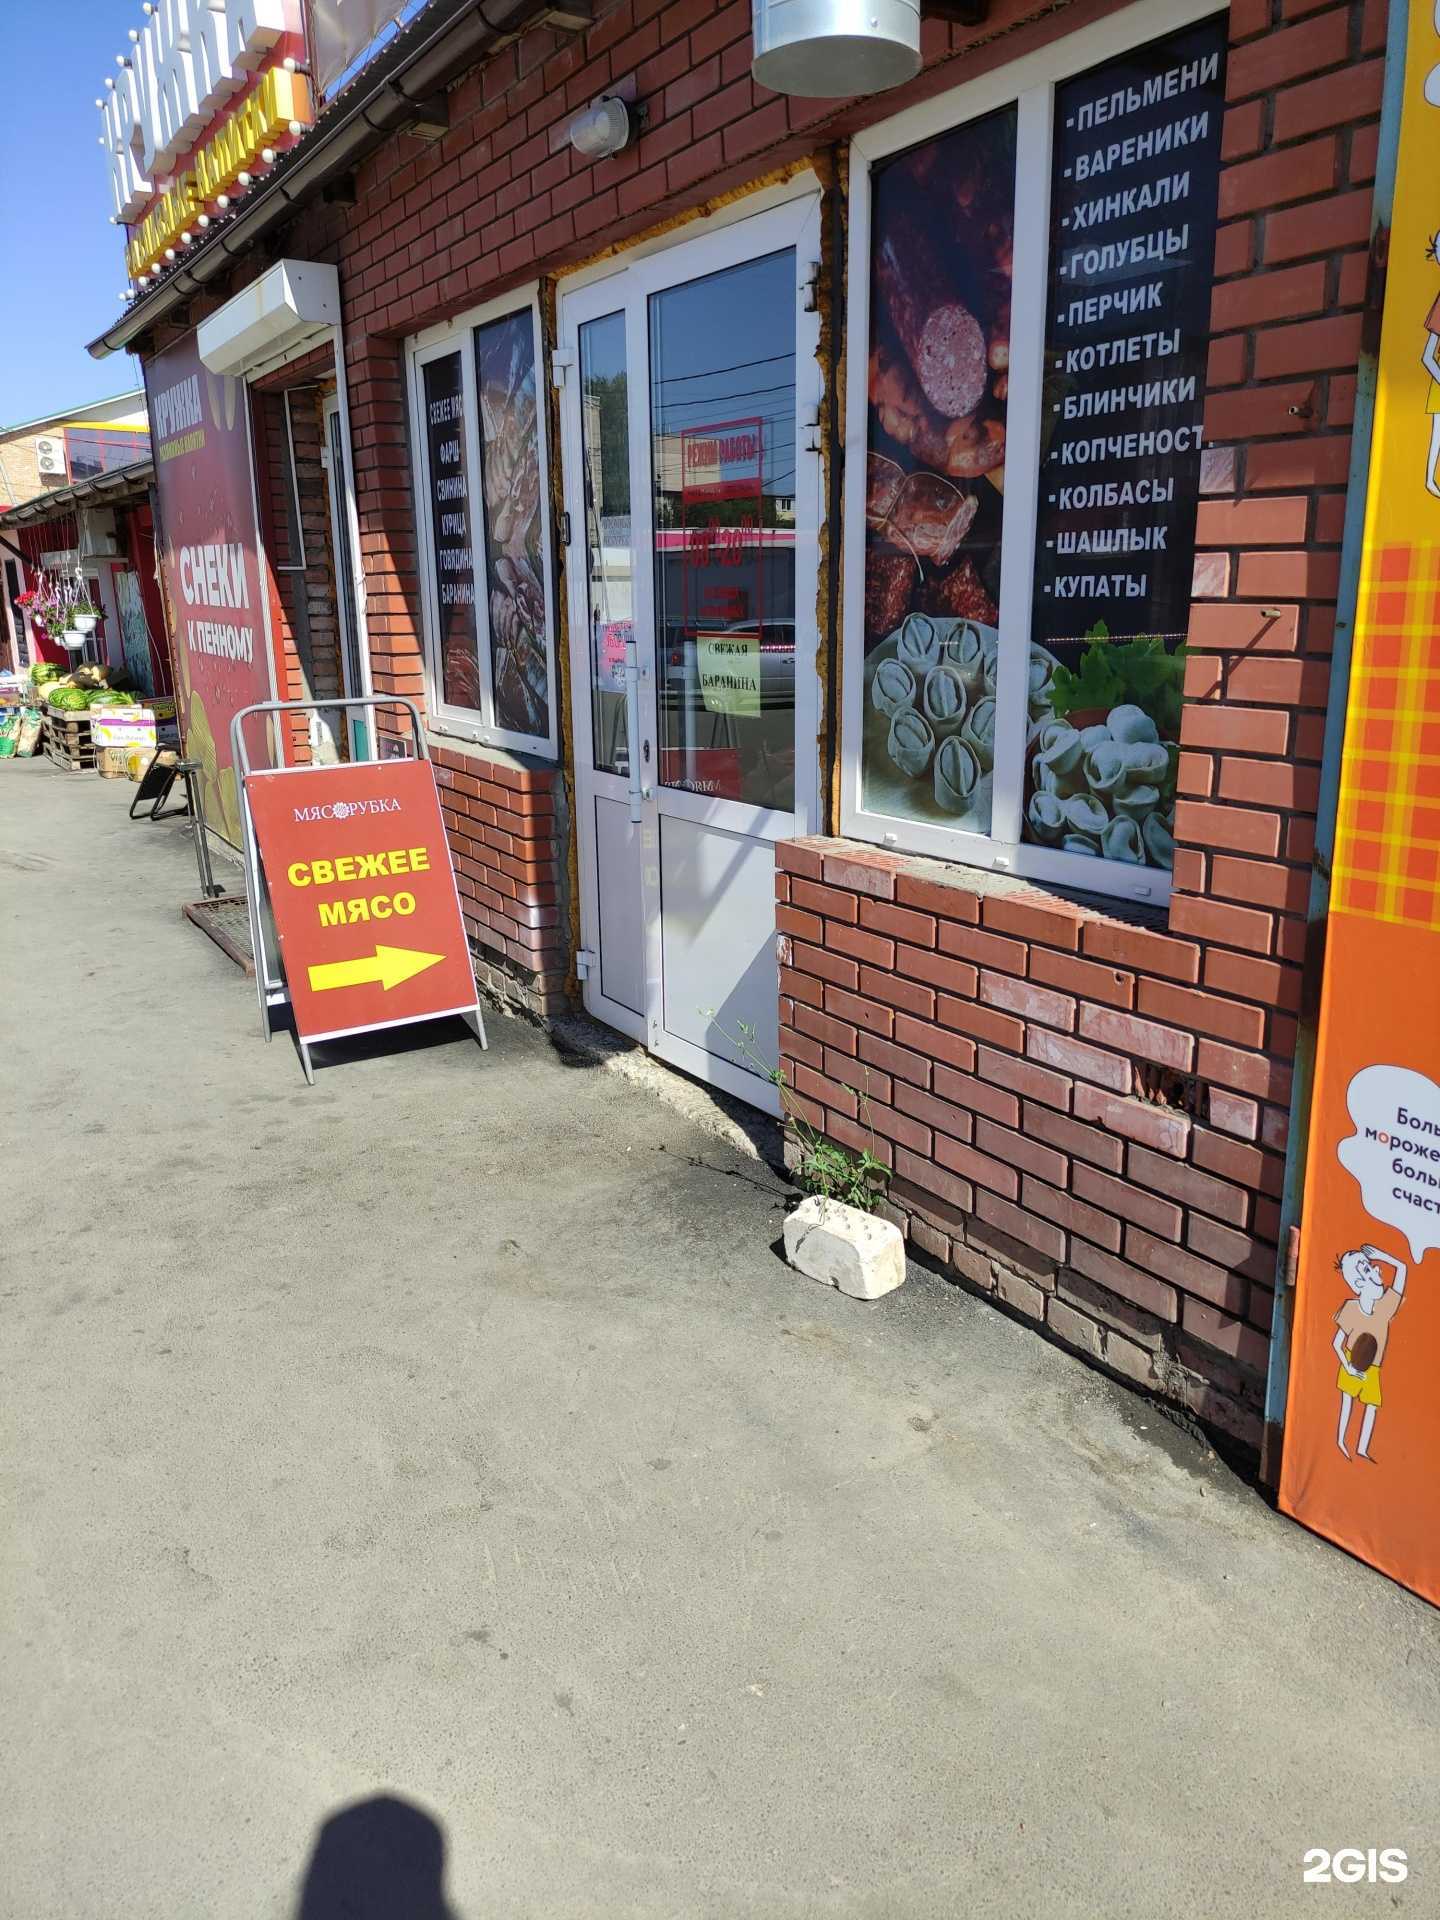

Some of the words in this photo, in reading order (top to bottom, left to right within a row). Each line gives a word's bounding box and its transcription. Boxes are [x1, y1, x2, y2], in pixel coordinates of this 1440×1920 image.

[1077, 52, 1220, 131] ПЕЛЬМЕНИ
[1075, 111, 1209, 181] ВАРЕНИКИ
[1072, 171, 1191, 231] ХИНКАЛИ
[1070, 224, 1189, 279] ГОЛУБЦЫ
[1068, 281, 1164, 327] ПЕРЧИК
[1066, 328, 1181, 373] КОТЛЕТЫ
[154, 374, 203, 440] КРУЖКА
[430, 397, 451, 425] СВЕЖЕЕ
[450, 393, 464, 418] МЯС
[1063, 375, 1196, 420] БЛИНЧИКИ
[440, 440, 460, 464] ФАРШ
[1061, 425, 1213, 465] КОПЧЕНОСТ
[437, 475, 468, 502] СВИНИНА
[1059, 477, 1174, 510] КОЛБАСЫ
[441, 512, 467, 537] КУРИЦА
[1056, 526, 1168, 554] ШАШЛЫК
[179, 543, 250, 608] СНЕКИ
[440, 547, 472, 574] ГОВЯДИНА
[442, 584, 475, 605] БАРАНИНА
[1054, 574, 1147, 598] КУПАТЫ
[187, 619, 197, 651] К
[196, 620, 253, 663] ПЕННОМУ
[708, 642, 748, 657] СВЕЖАЯ
[702, 673, 757, 690] БАРАНИНА
[287, 847, 430, 887] СВЕЖЕЕ
[318, 891, 416, 927] МЯСО
[1392, 1157, 1440, 1189] боль
